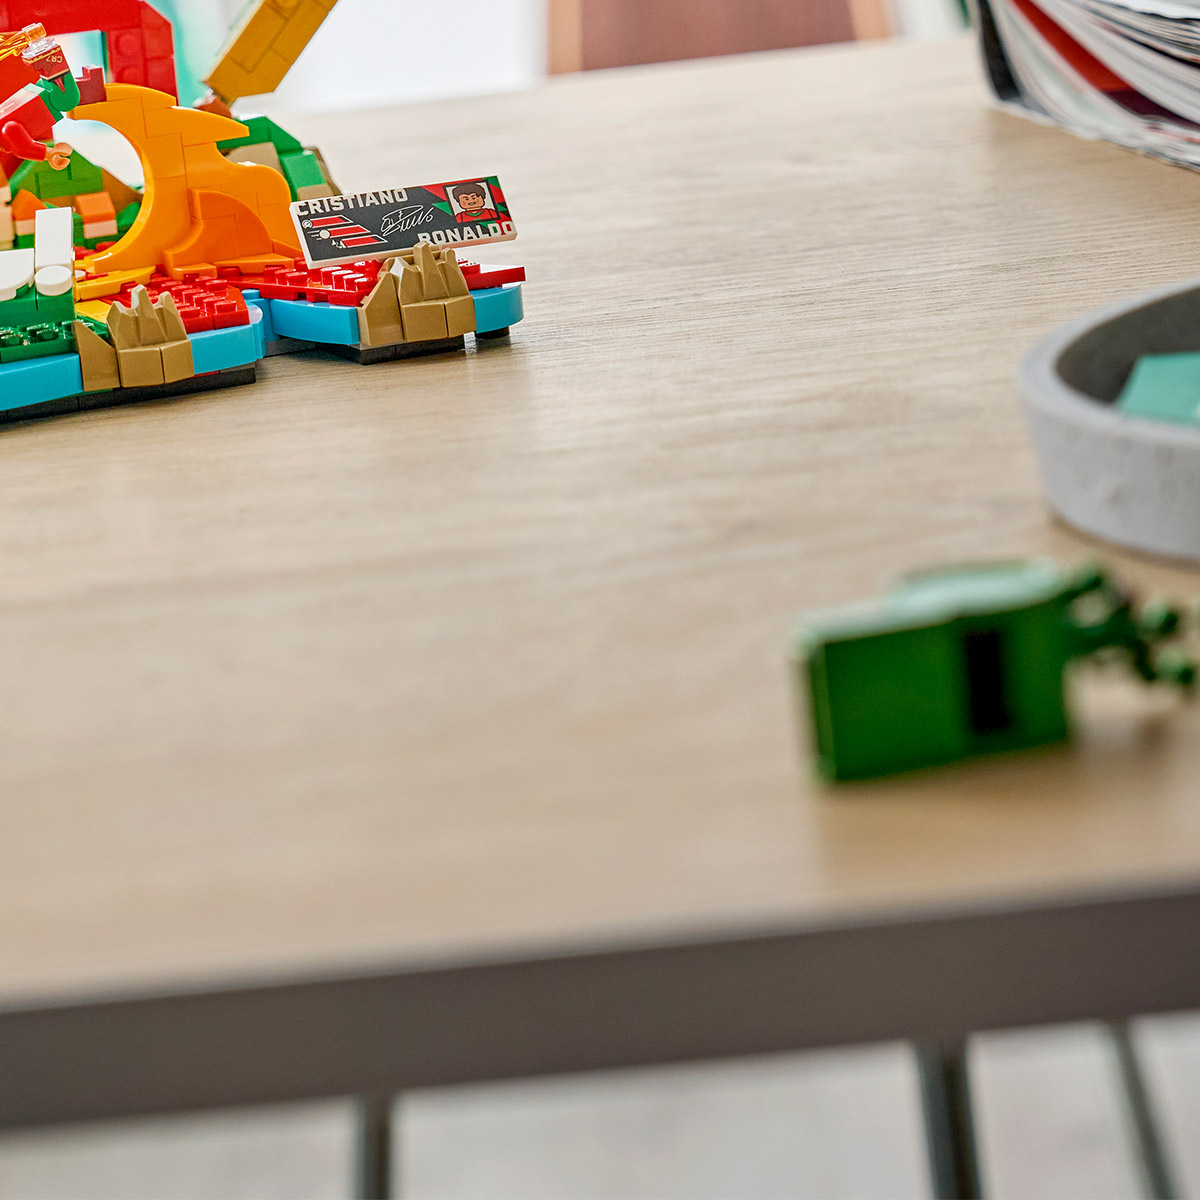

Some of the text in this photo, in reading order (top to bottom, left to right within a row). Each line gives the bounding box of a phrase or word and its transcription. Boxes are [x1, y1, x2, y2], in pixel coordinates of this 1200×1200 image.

[45, 55, 64, 63] CR7
[296, 187, 408, 216] CRISTIANO
[417, 221, 516, 246] RONALDO
